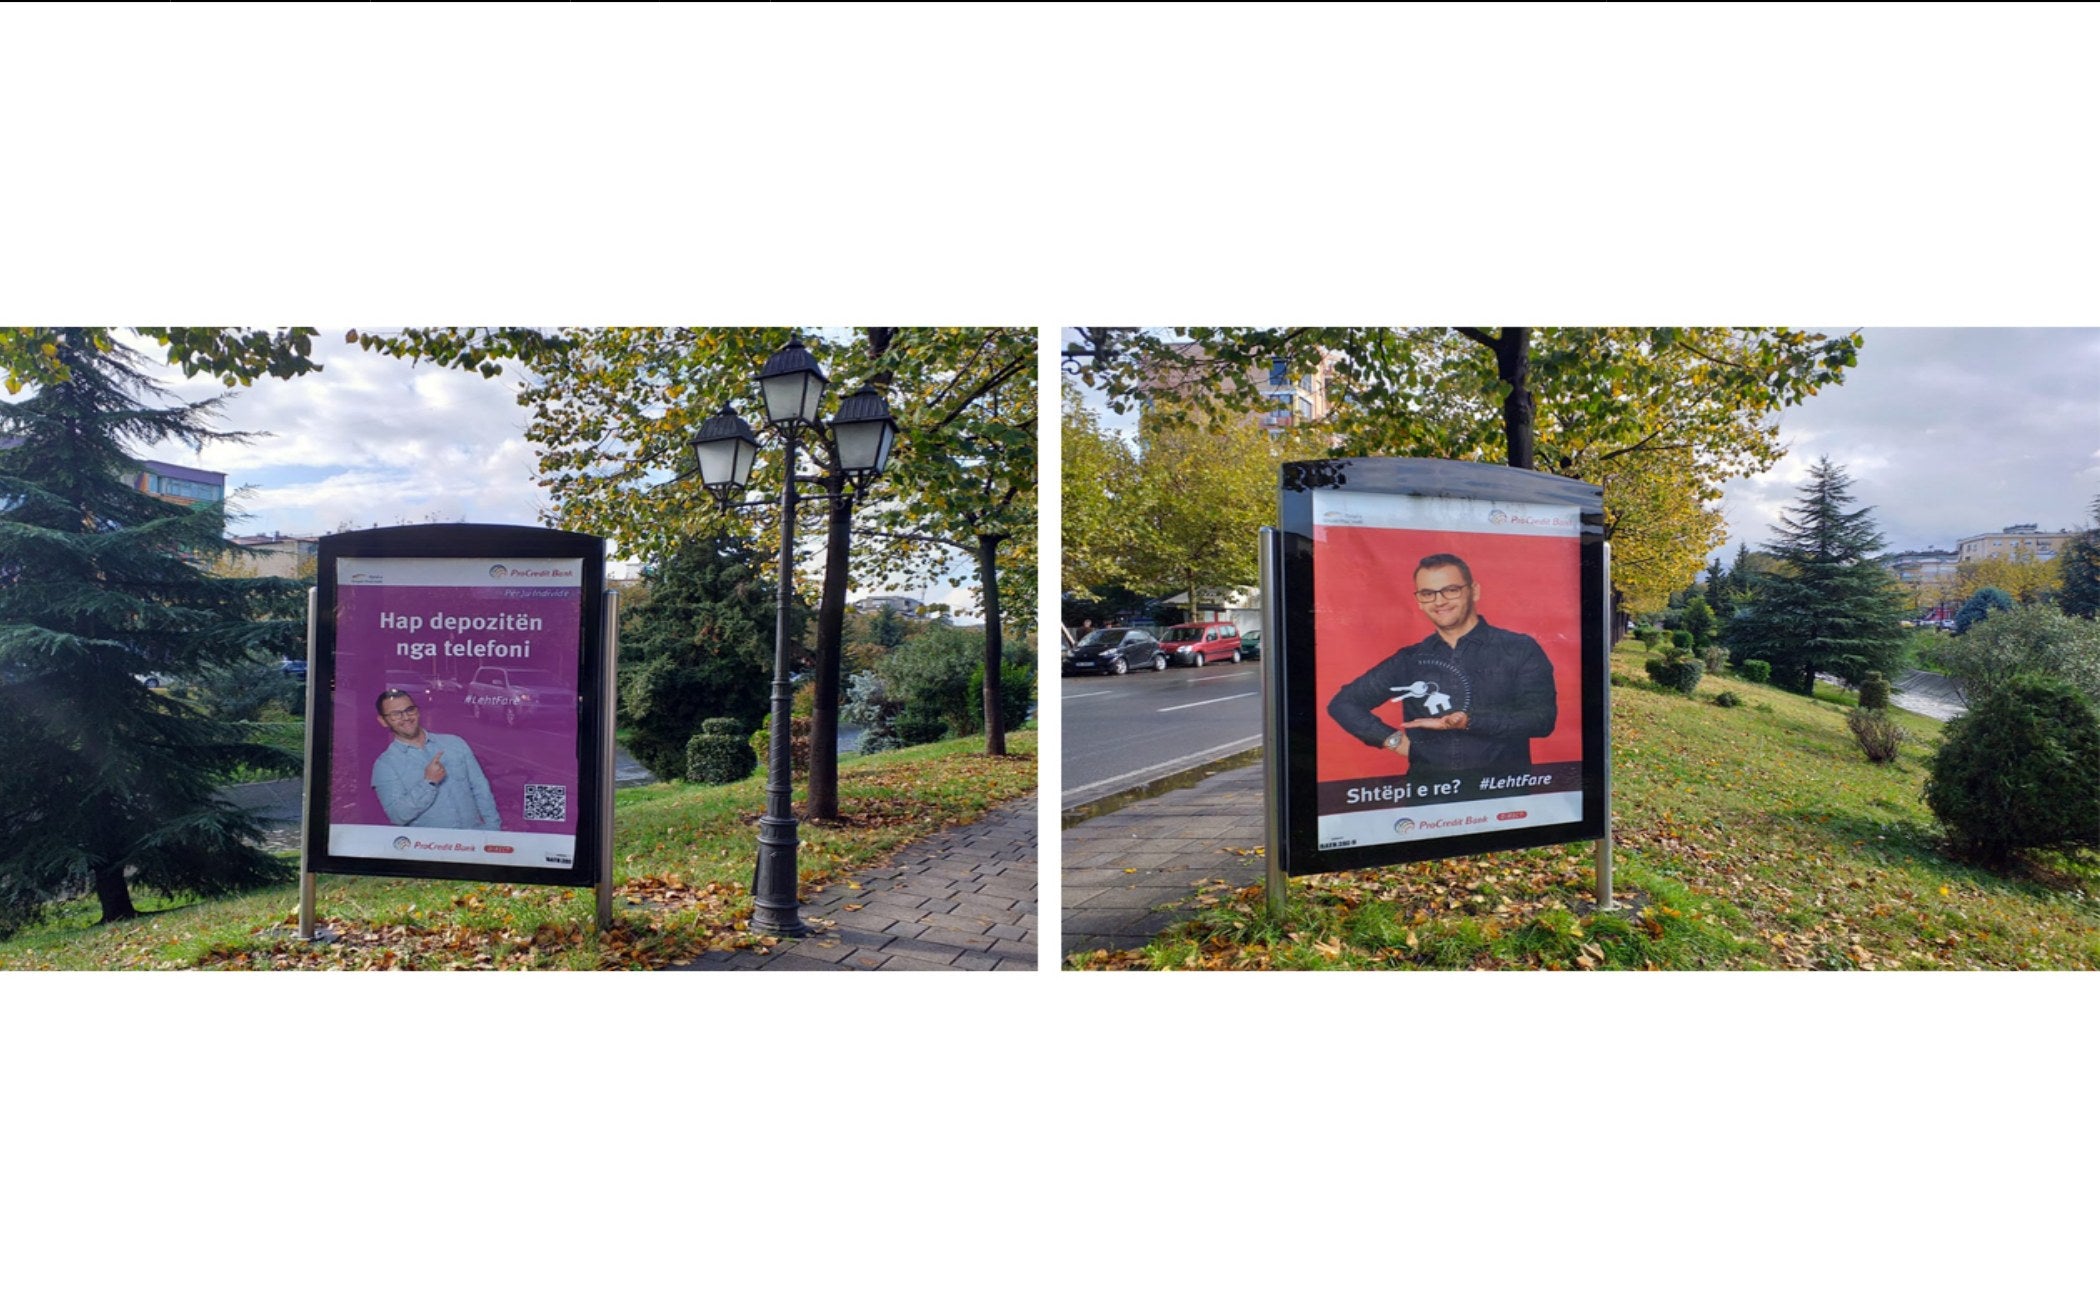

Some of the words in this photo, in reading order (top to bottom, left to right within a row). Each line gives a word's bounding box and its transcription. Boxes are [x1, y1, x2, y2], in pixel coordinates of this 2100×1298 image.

[380, 612, 423, 633] Hap
[430, 613, 542, 634] depozitën
[397, 642, 437, 660] nga
[444, 640, 530, 658] telefoni
[465, 694, 520, 705] #LehtFare
[1479, 774, 1552, 791] #LehtFare
[1346, 782, 1412, 804] Shtëpi
[1417, 786, 1428, 797] e
[1433, 779, 1461, 795] re?
[1420, 818, 1463, 830] ProCredit
[1465, 815, 1489, 825] Bank
[414, 842, 452, 851] ProCredit
